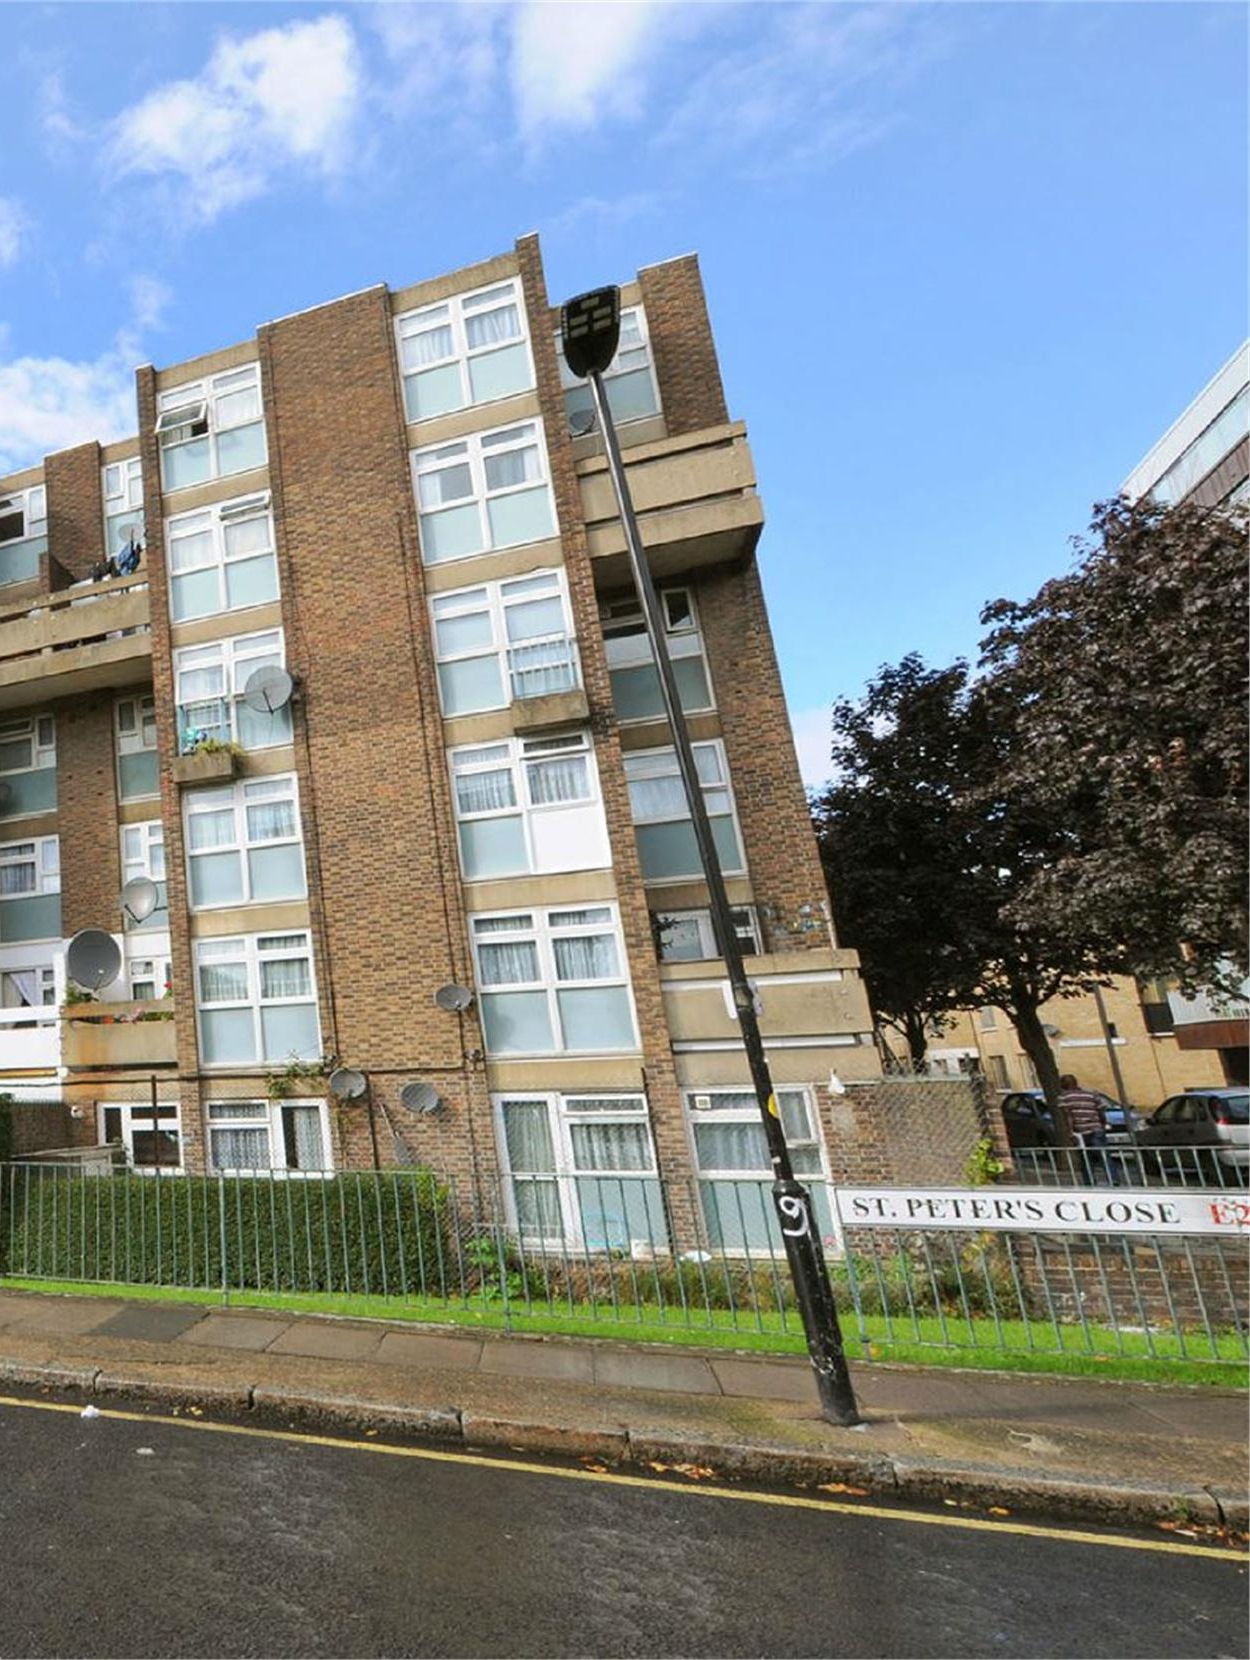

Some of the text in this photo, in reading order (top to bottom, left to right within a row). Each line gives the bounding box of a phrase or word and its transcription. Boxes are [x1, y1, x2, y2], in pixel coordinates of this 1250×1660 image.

[852, 1197, 897, 1218] ST.
[906, 1198, 1044, 1221] PETER'S
[1054, 1201, 1181, 1224] CLOSE
